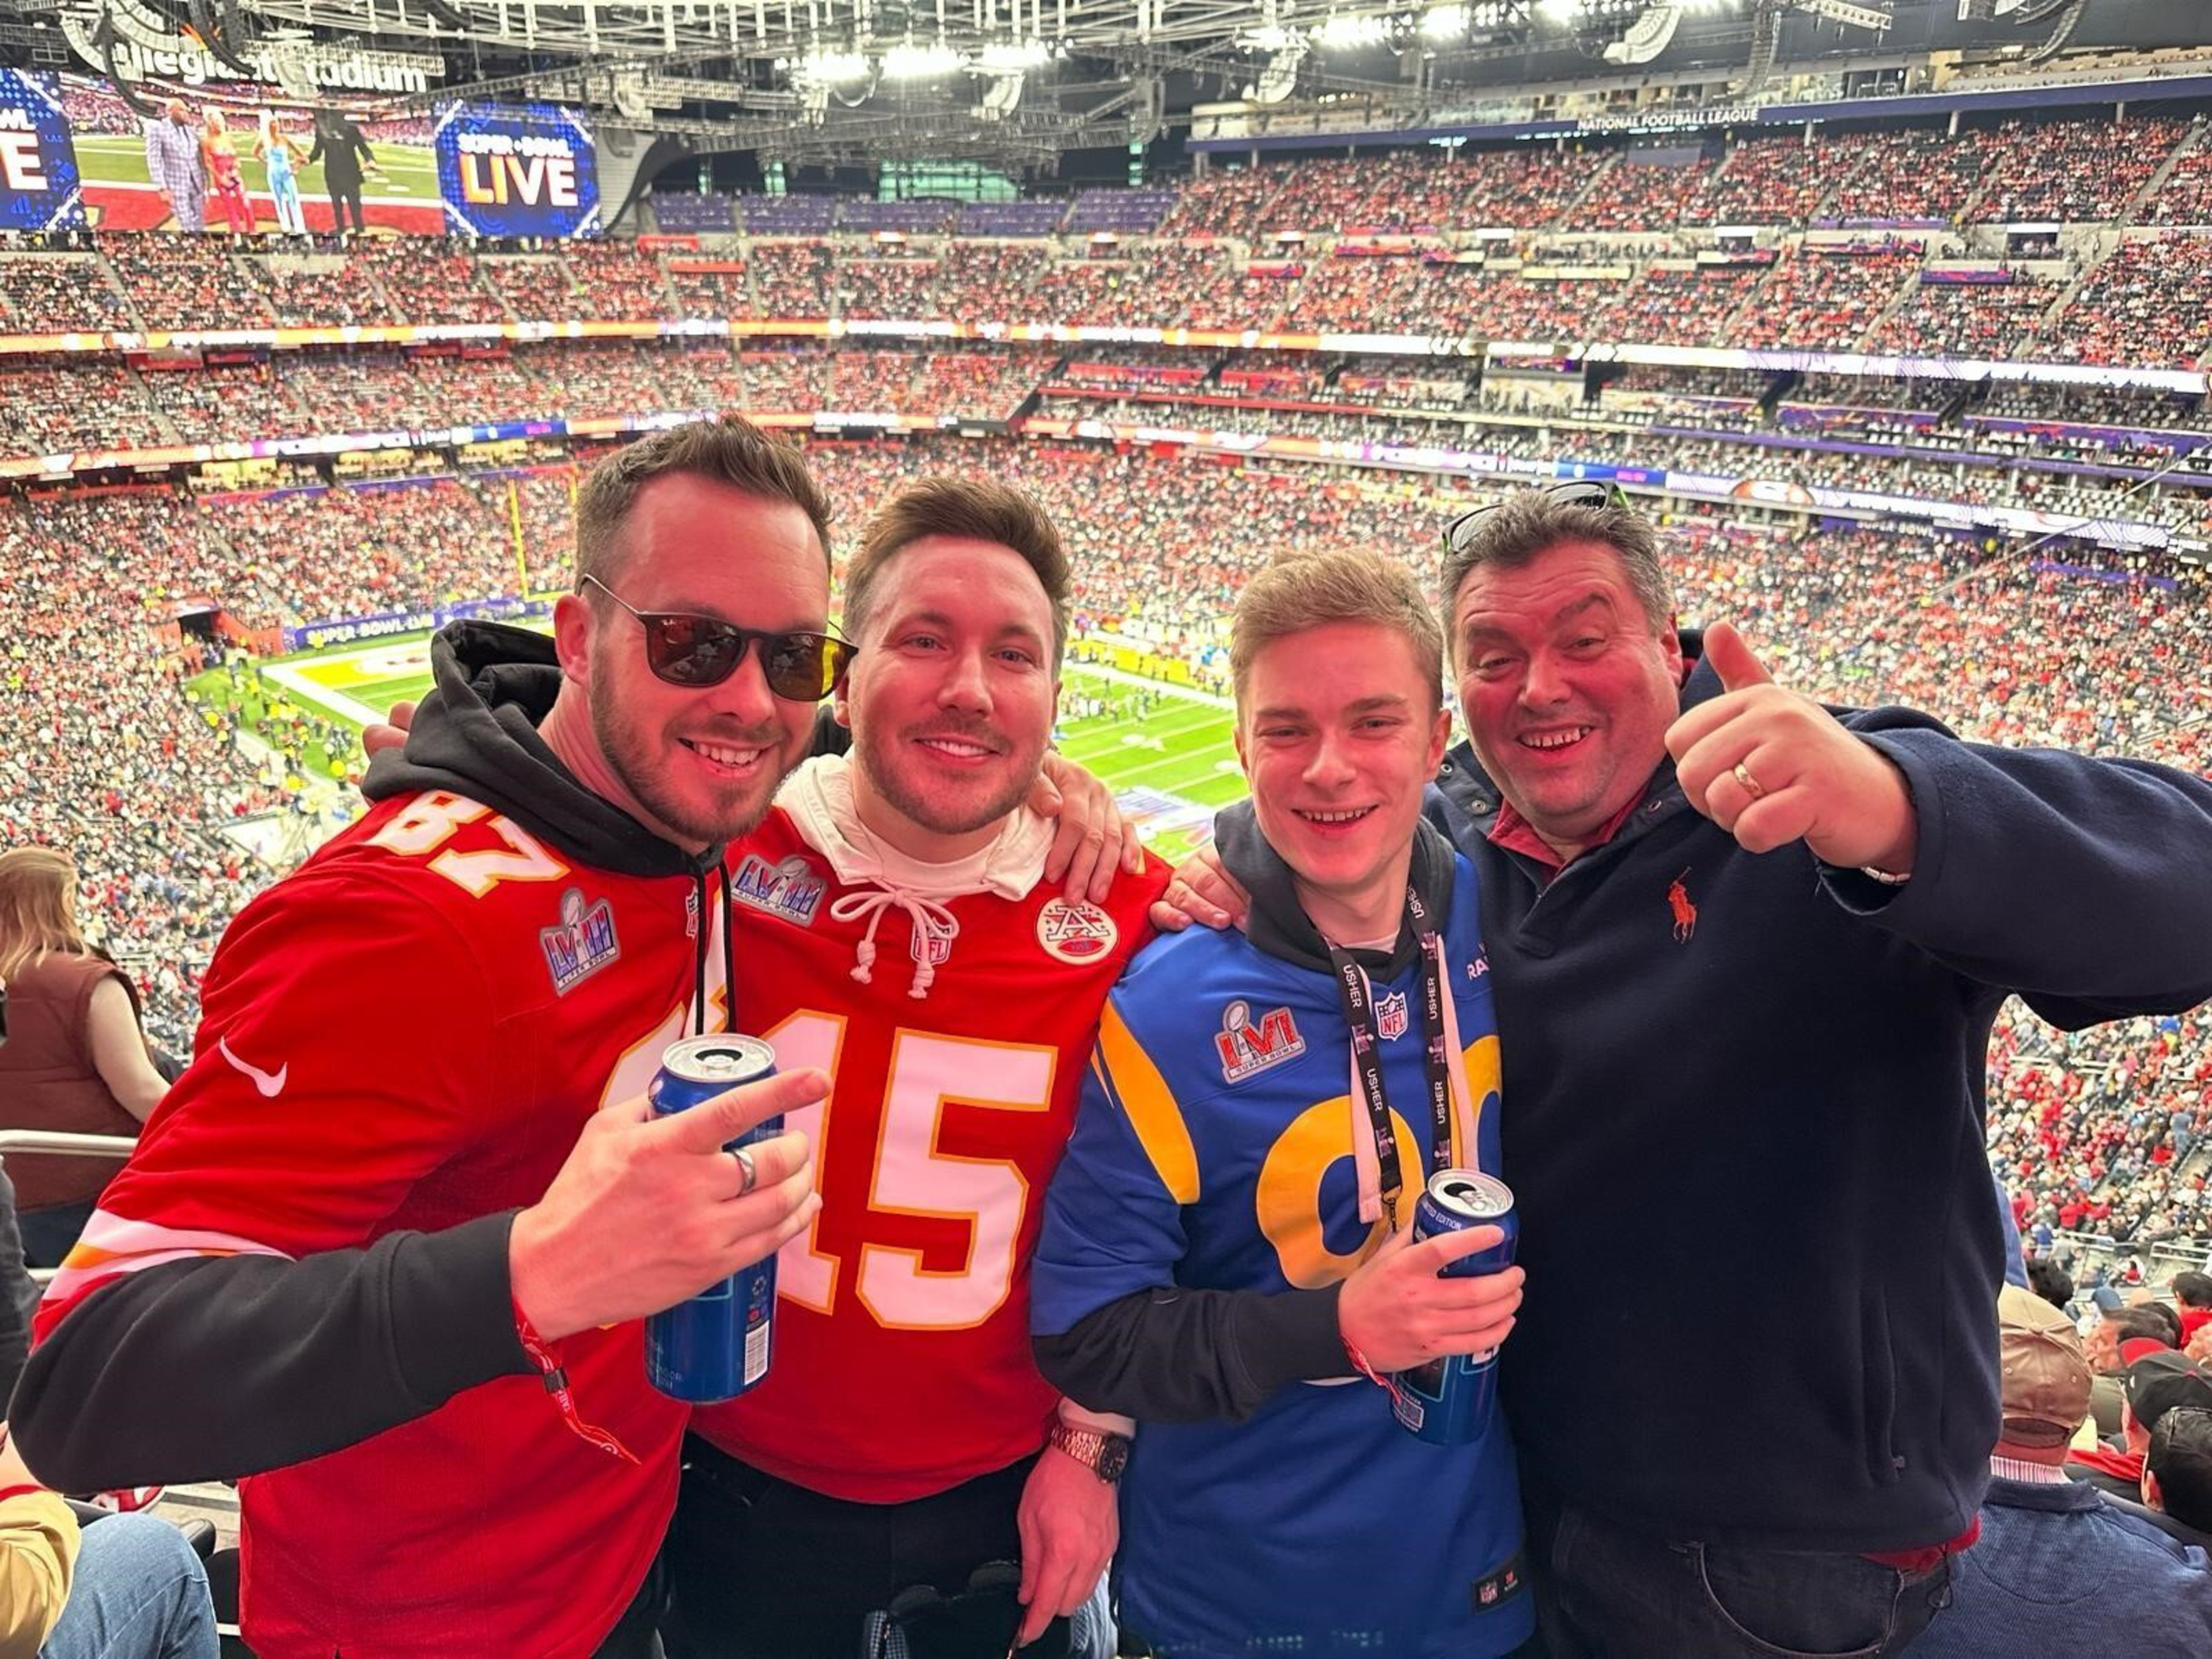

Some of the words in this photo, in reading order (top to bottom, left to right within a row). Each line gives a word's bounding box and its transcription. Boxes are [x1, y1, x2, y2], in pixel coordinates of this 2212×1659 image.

[113, 41, 278, 85] llegit
[305, 53, 426, 92] tadium
[1577, 118, 1638, 130] NATIONAL
[1642, 112, 1705, 128] FOOTBALL
[1707, 108, 1759, 123] LEAGUE
[457, 133, 513, 154] SUPER
[521, 136, 574, 158] BOWL
[460, 153, 578, 206] LIVE
[361, 618, 402, 637] BOWL
[361, 790, 571, 899] 87
[1343, 964, 1362, 1007] USHER
[1427, 977, 1438, 1020] USHER
[1219, 1012, 1296, 1070] LVI
[1383, 1013, 1403, 1033] NFL
[1236, 1056, 1267, 1073] SUPER
[1270, 1044, 1296, 1059] BOWL
[1367, 1068, 1383, 1111] USHER
[1434, 1081, 1445, 1124] USHER
[759, 1008, 1059, 1331] 15
[1420, 1196, 1436, 1218] ITED
[1435, 1213, 1463, 1231] EDITION
